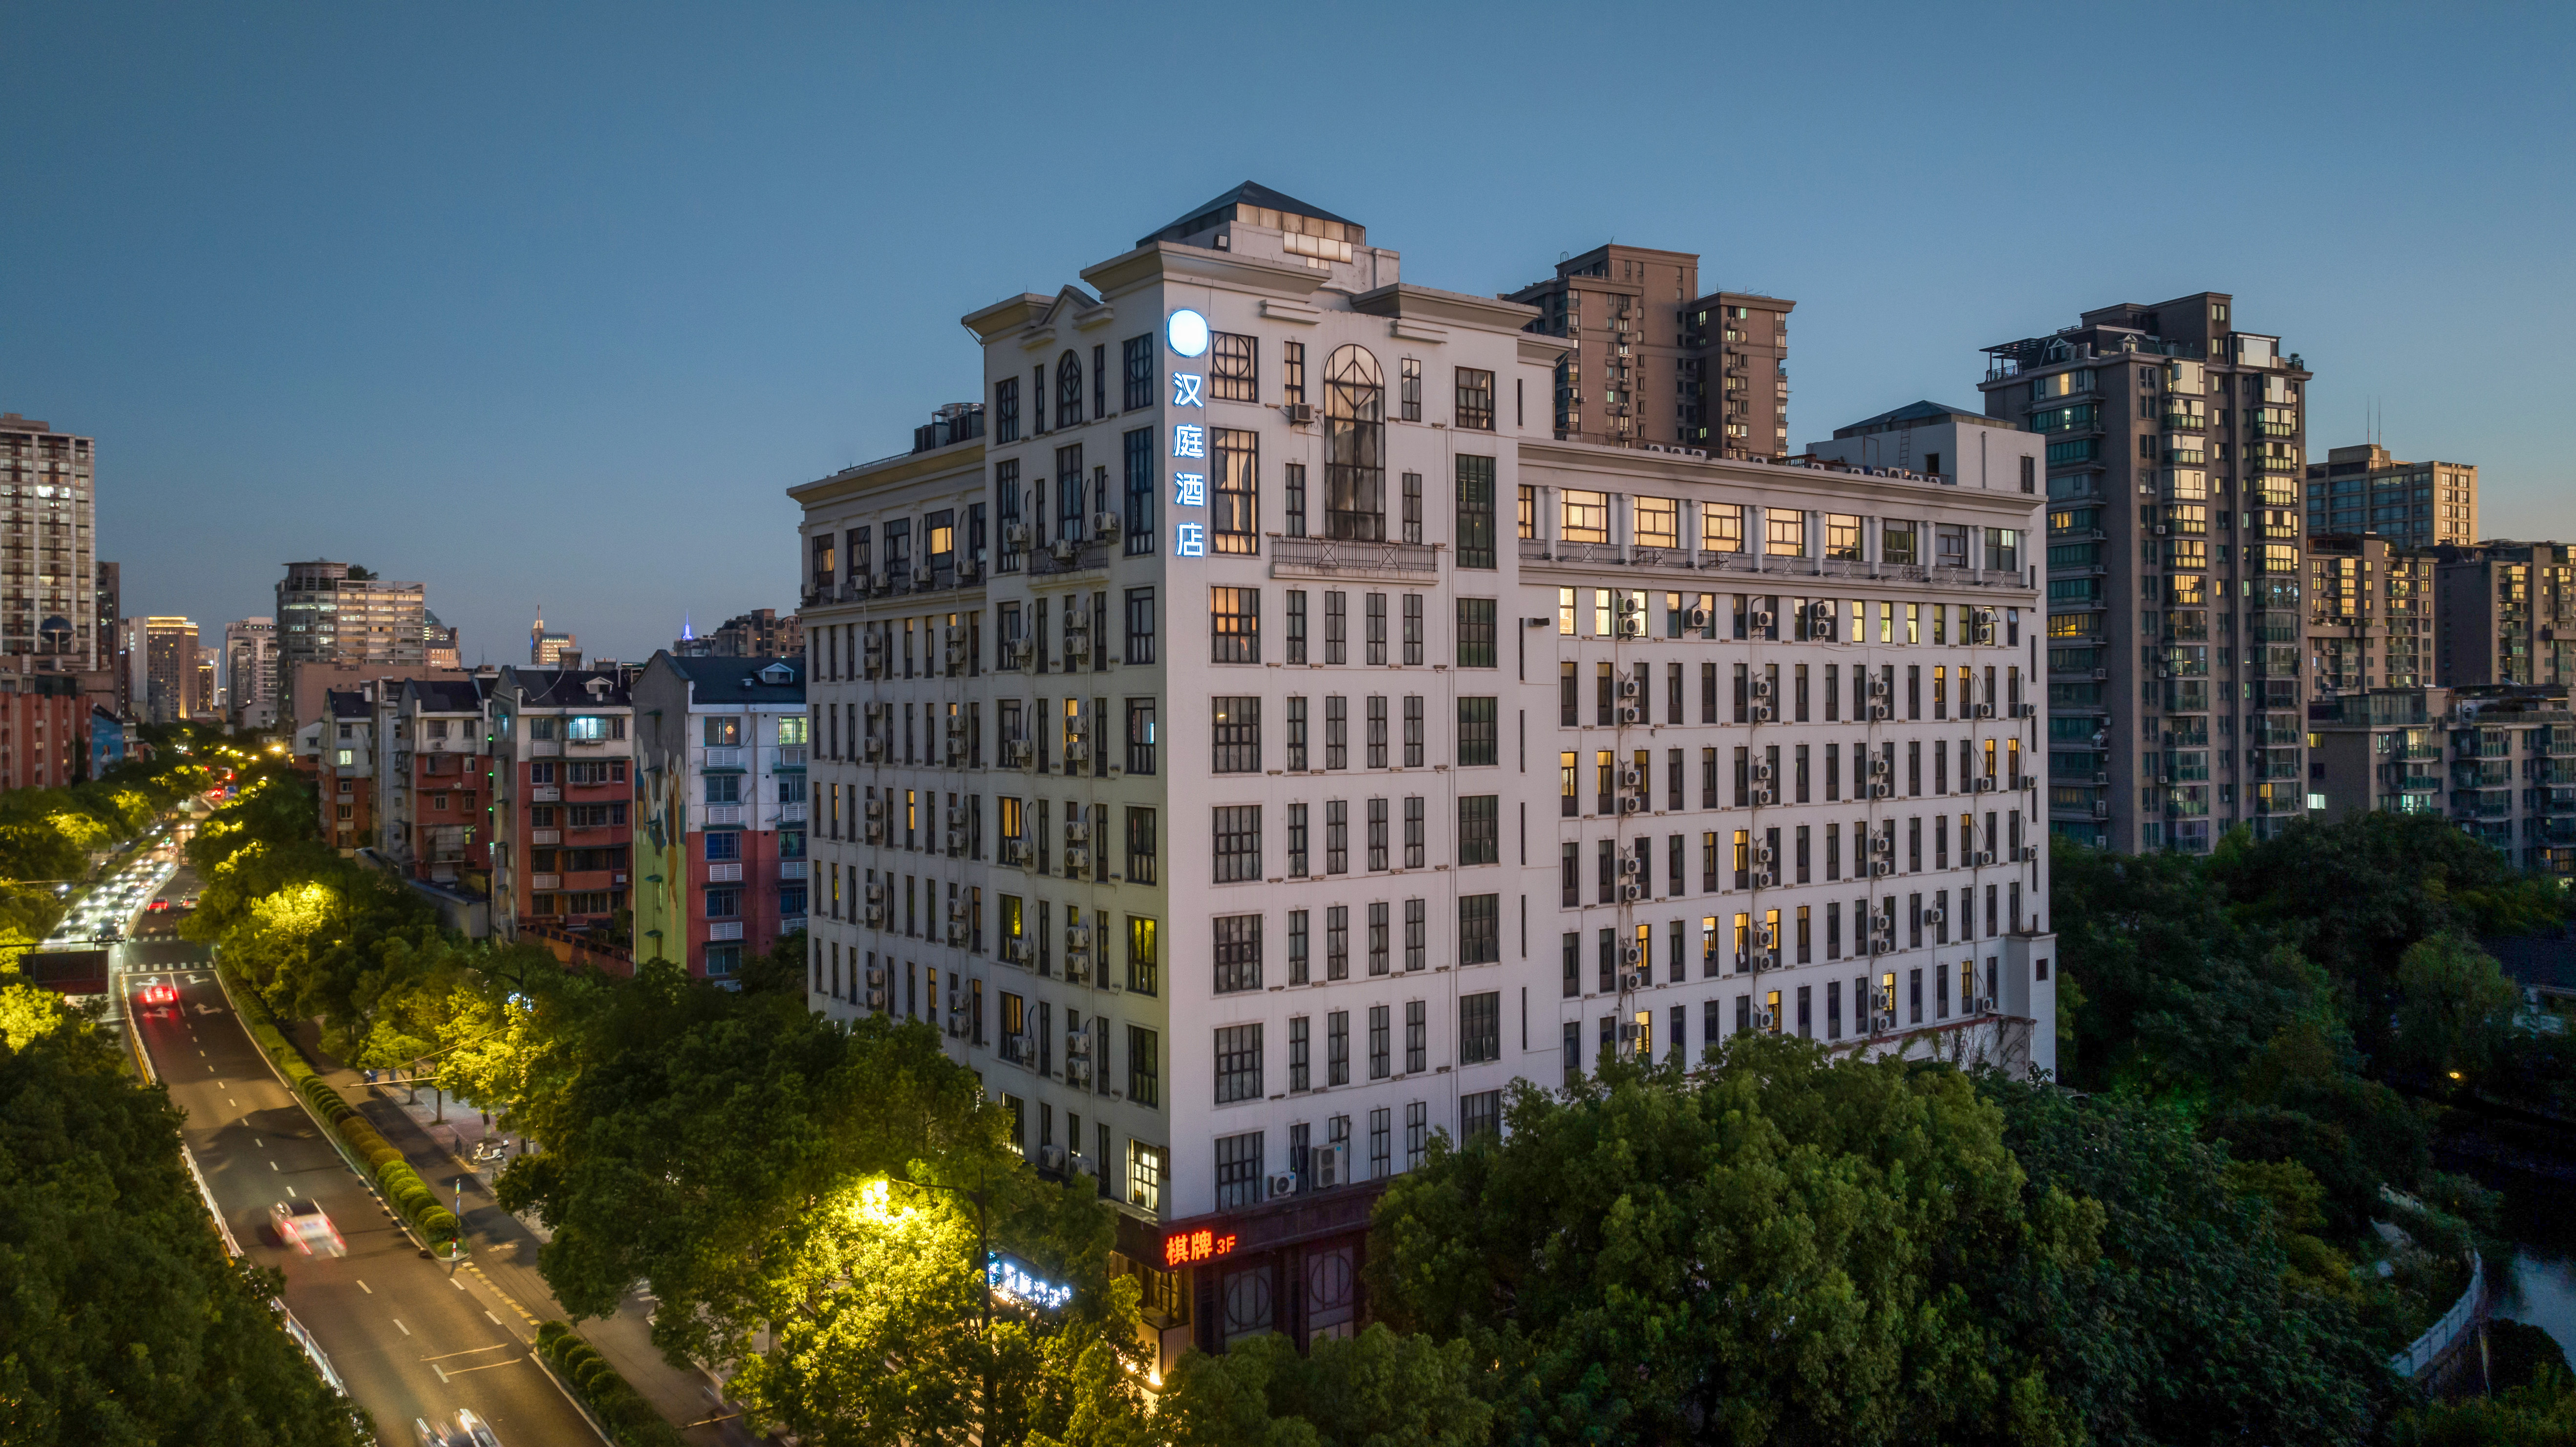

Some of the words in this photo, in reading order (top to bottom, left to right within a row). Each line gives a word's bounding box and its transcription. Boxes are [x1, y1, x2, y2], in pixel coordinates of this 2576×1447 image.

[1173, 372, 1204, 556] 汉庭酒店
[1166, 1230, 1213, 1266] 棋牌
[1217, 1235, 1235, 1254] 3F
